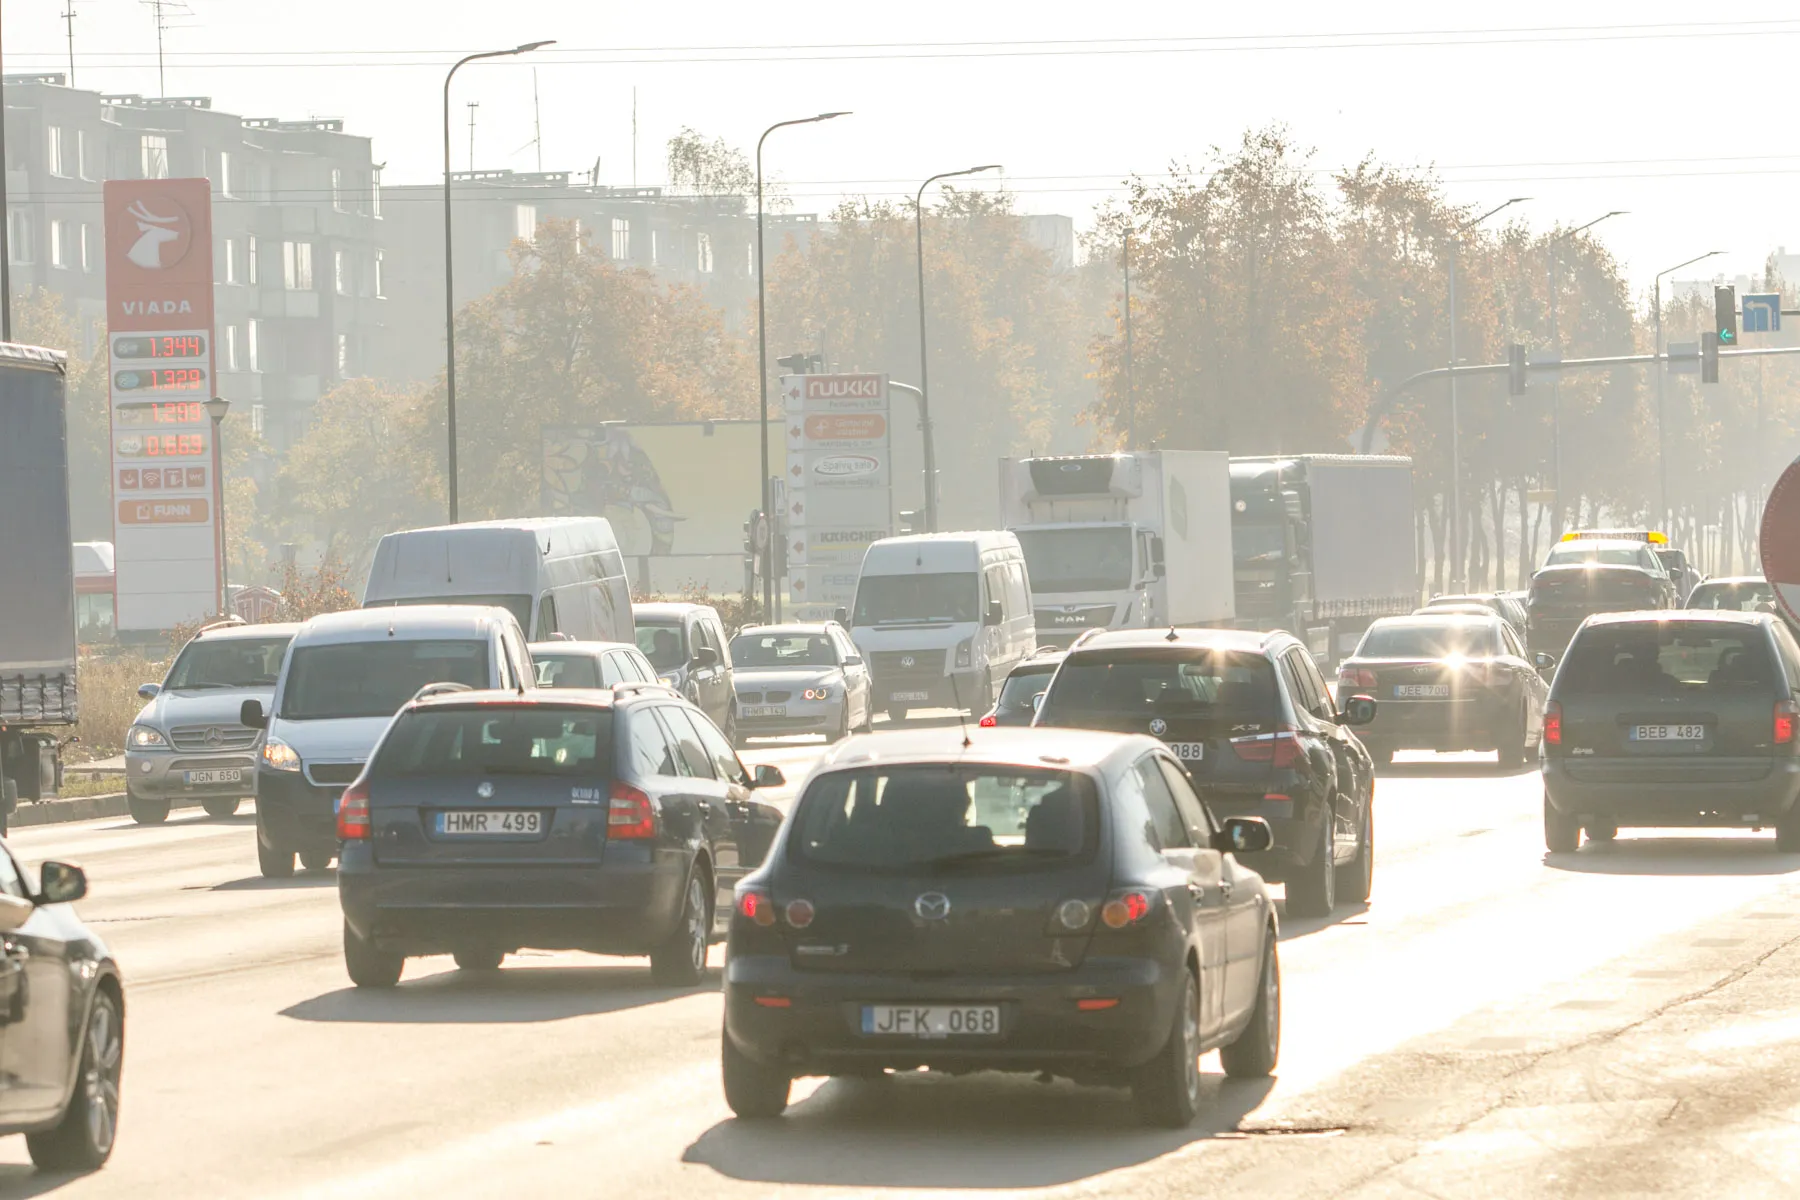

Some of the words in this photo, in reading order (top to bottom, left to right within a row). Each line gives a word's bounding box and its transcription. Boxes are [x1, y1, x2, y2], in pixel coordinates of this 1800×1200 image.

[122, 299, 192, 315] VIADA
[150, 336, 199, 357] 1.344
[151, 369, 200, 390] 1.329
[153, 504, 191, 516] FUNN
[1055, 615, 1086, 623] MAN
[1400, 686, 1422, 695] JEE
[1638, 726, 1668, 738] BEB
[1676, 726, 1702, 738] 482
[191, 772, 213, 782] JGN
[219, 771, 239, 781] 650
[446, 814, 489, 832] HMR
[501, 814, 538, 831] 499
[878, 1009, 930, 1032] JFK
[949, 1009, 995, 1032] 068
